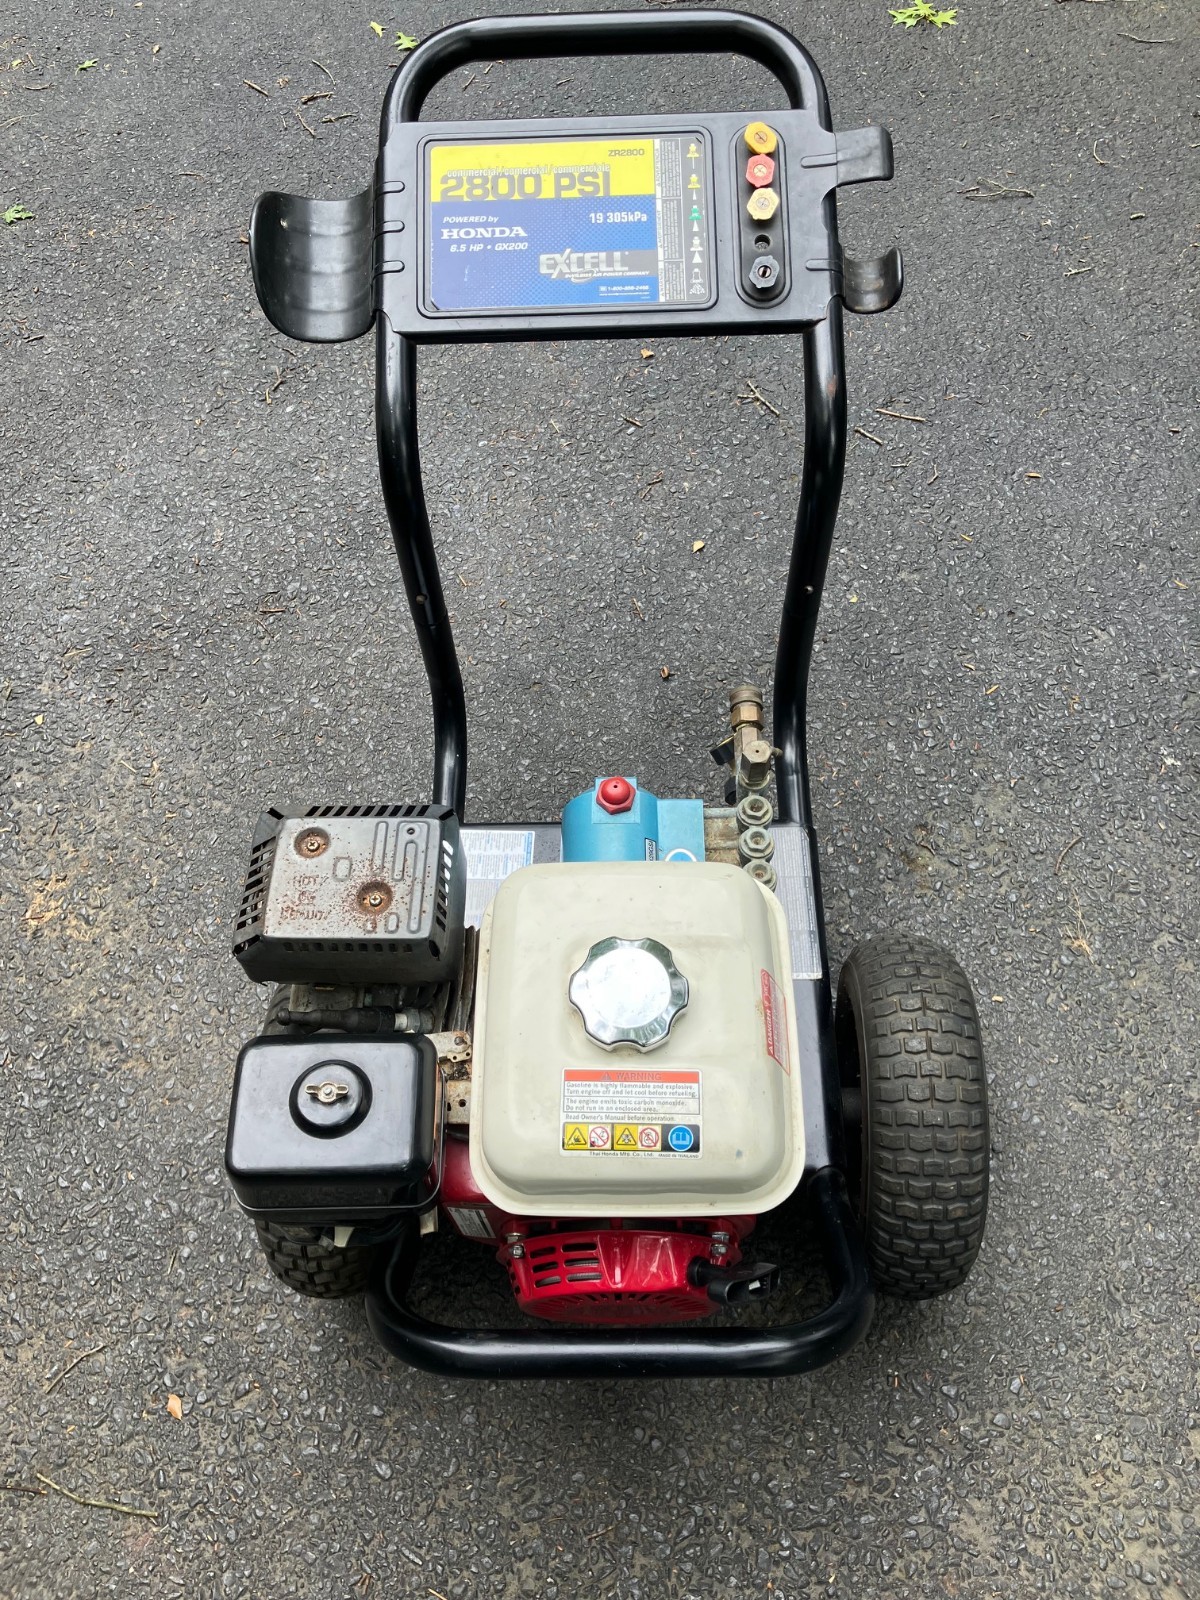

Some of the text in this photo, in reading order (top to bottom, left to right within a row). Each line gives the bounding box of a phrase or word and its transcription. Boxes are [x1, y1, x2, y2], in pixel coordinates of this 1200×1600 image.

[608, 148, 645, 157] ZR2800
[440, 170, 610, 202] 2800 PSI
[442, 216, 499, 224] POWERED by
[589, 212, 648, 224] 19 305kPa
[440, 226, 528, 240] HONDA
[450, 242, 528, 252] 6.5 HP GX200
[540, 248, 628, 278] EXCELL
[616, 1072, 662, 1081] WARNING
